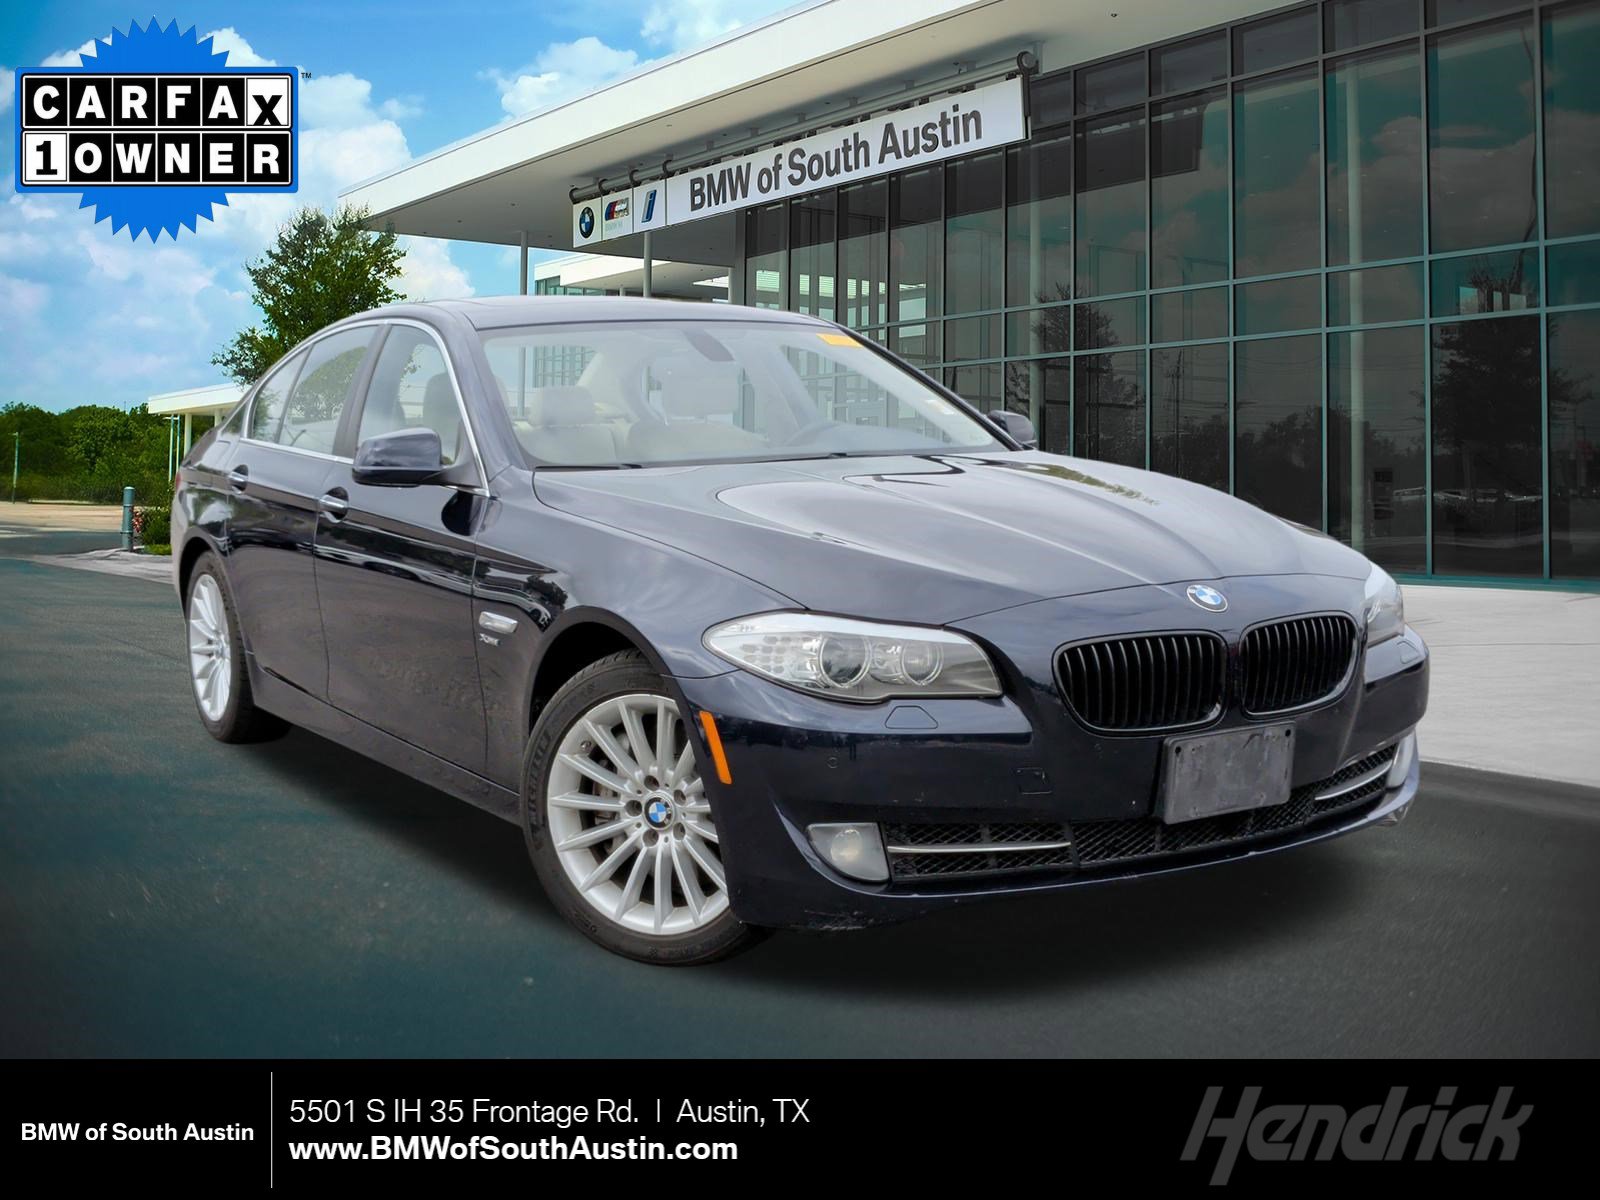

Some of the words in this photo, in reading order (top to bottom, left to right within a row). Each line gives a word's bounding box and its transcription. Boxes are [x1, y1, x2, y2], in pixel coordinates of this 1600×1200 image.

[689, 162, 752, 212] BMW
[757, 152, 783, 194] of
[787, 131, 870, 187] South
[878, 103, 983, 165] Austin
